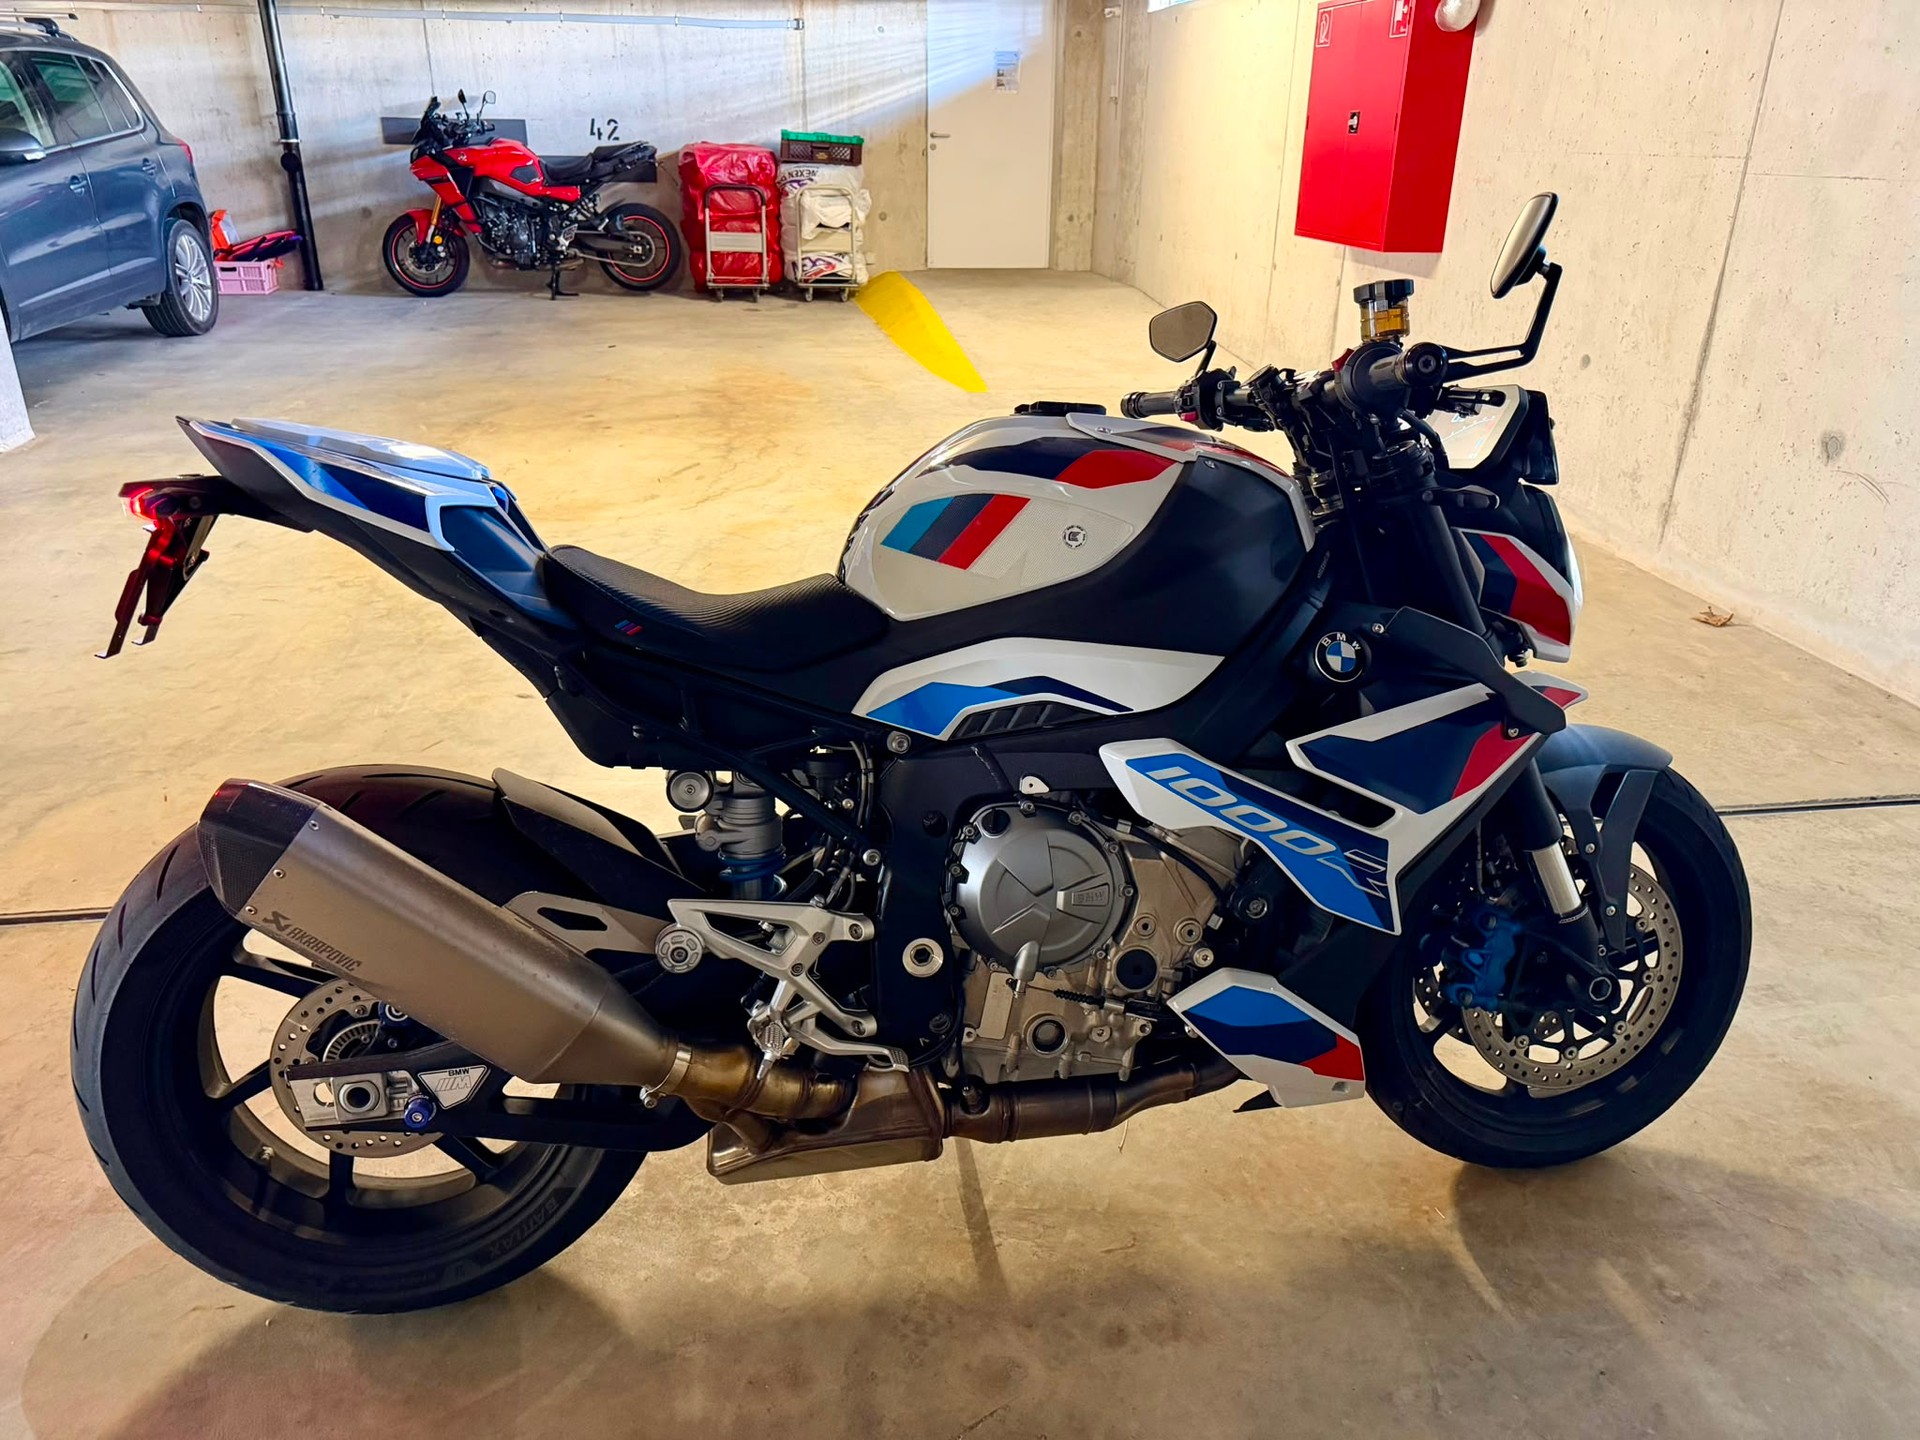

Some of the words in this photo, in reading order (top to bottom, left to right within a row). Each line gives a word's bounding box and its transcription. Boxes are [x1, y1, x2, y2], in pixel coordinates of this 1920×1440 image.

[590, 118, 620, 141] 42
[1321, 632, 1361, 650] BMW
[448, 1068, 470, 1077] BMW
